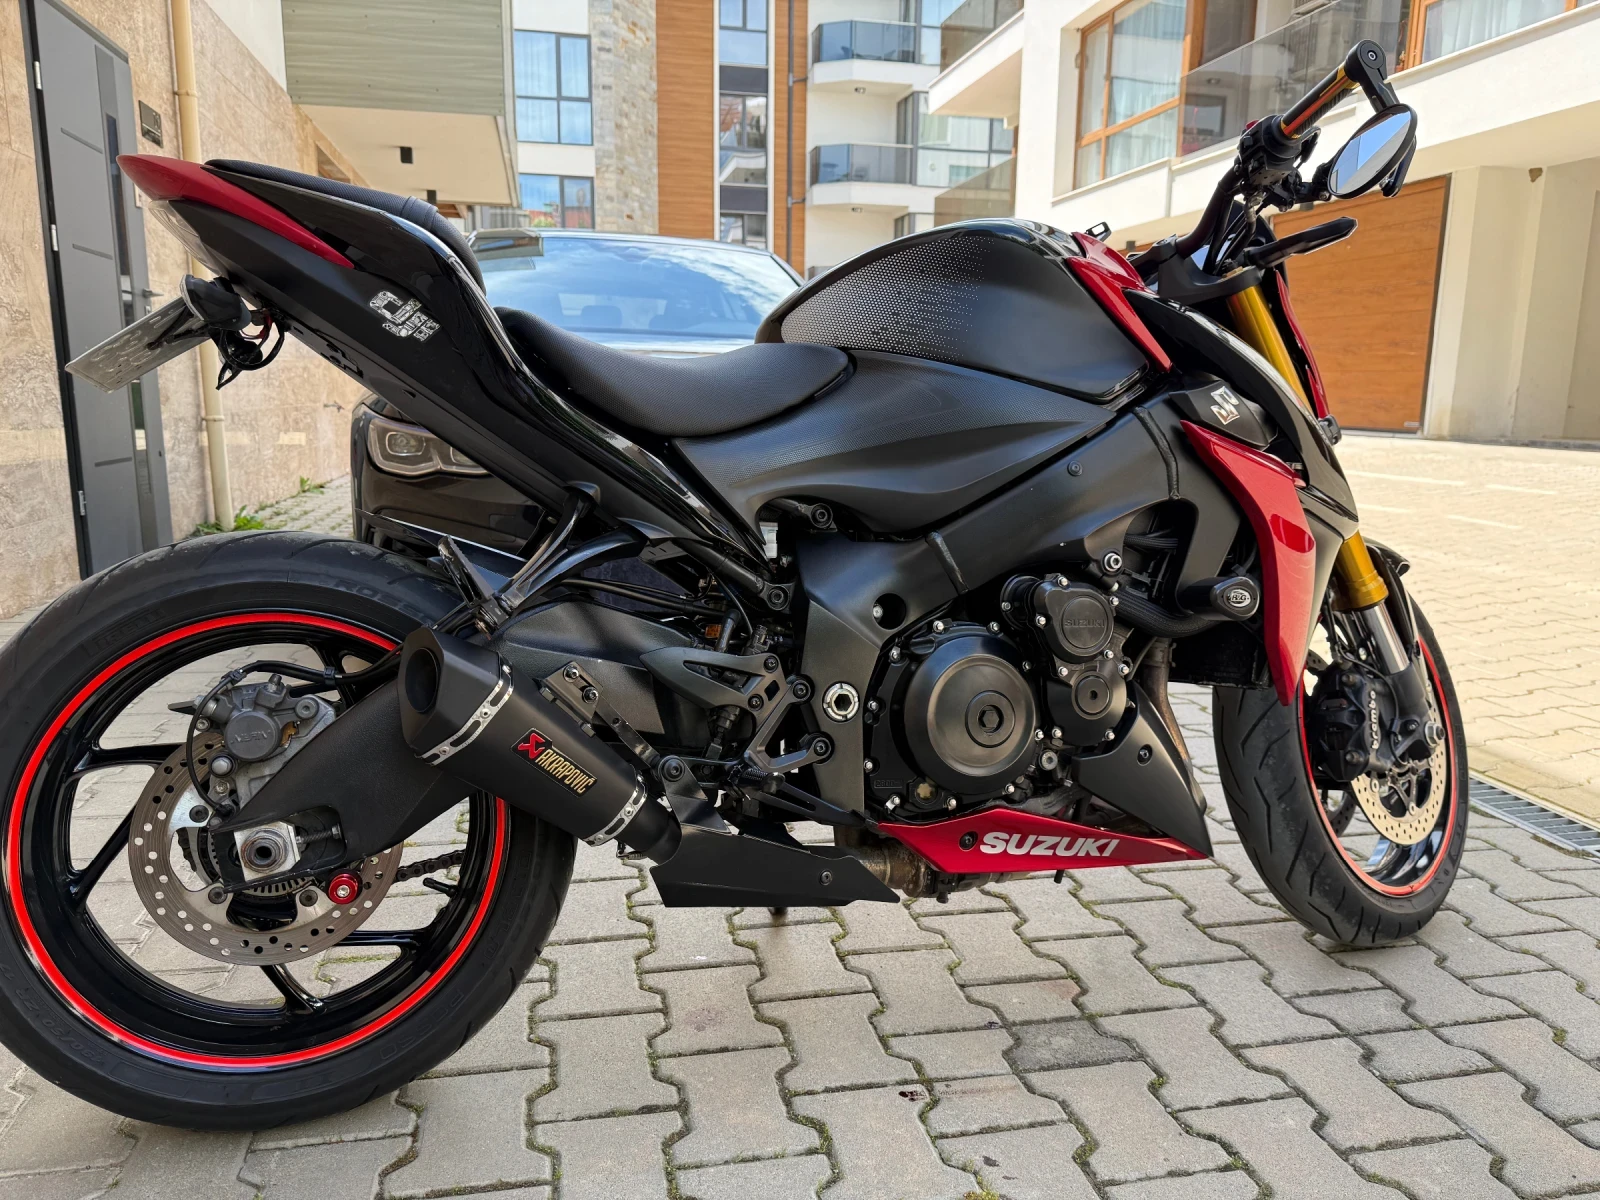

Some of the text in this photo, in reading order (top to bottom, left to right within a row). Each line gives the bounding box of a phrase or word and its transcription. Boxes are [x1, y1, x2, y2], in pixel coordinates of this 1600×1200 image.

[1064, 618, 1105, 627] SUZUKI
[1368, 690, 1379, 749] brembo
[979, 831, 1120, 856] SUZUKI
